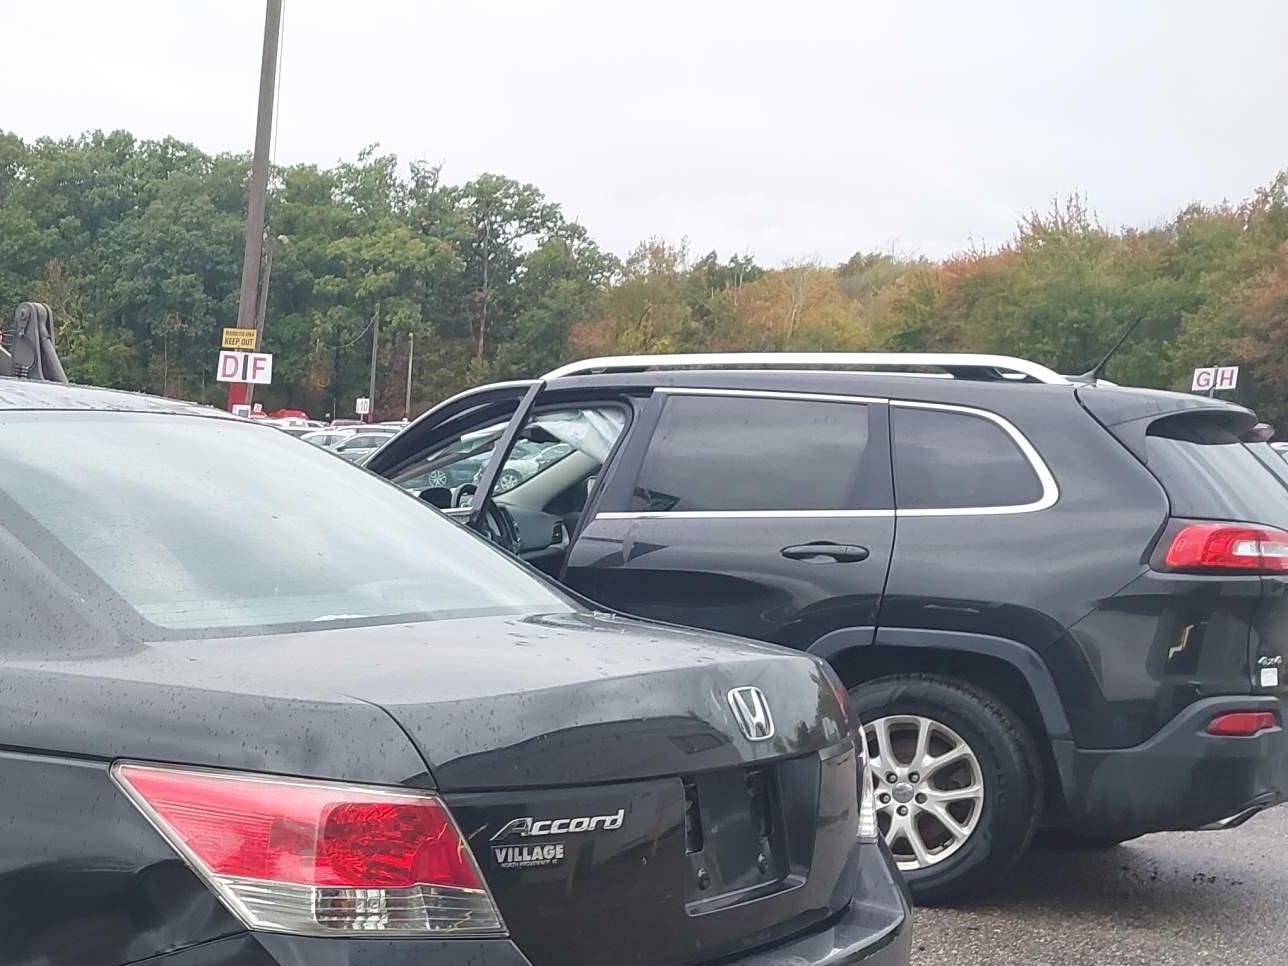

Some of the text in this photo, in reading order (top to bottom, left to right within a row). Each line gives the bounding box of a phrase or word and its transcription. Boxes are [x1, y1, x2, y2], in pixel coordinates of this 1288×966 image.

[224, 337, 255, 346] KEEP OUT
[221, 354, 267, 380] D F
[1196, 369, 1235, 388] G H
[489, 809, 625, 841] Accord
[495, 844, 564, 863] VILLAGE
